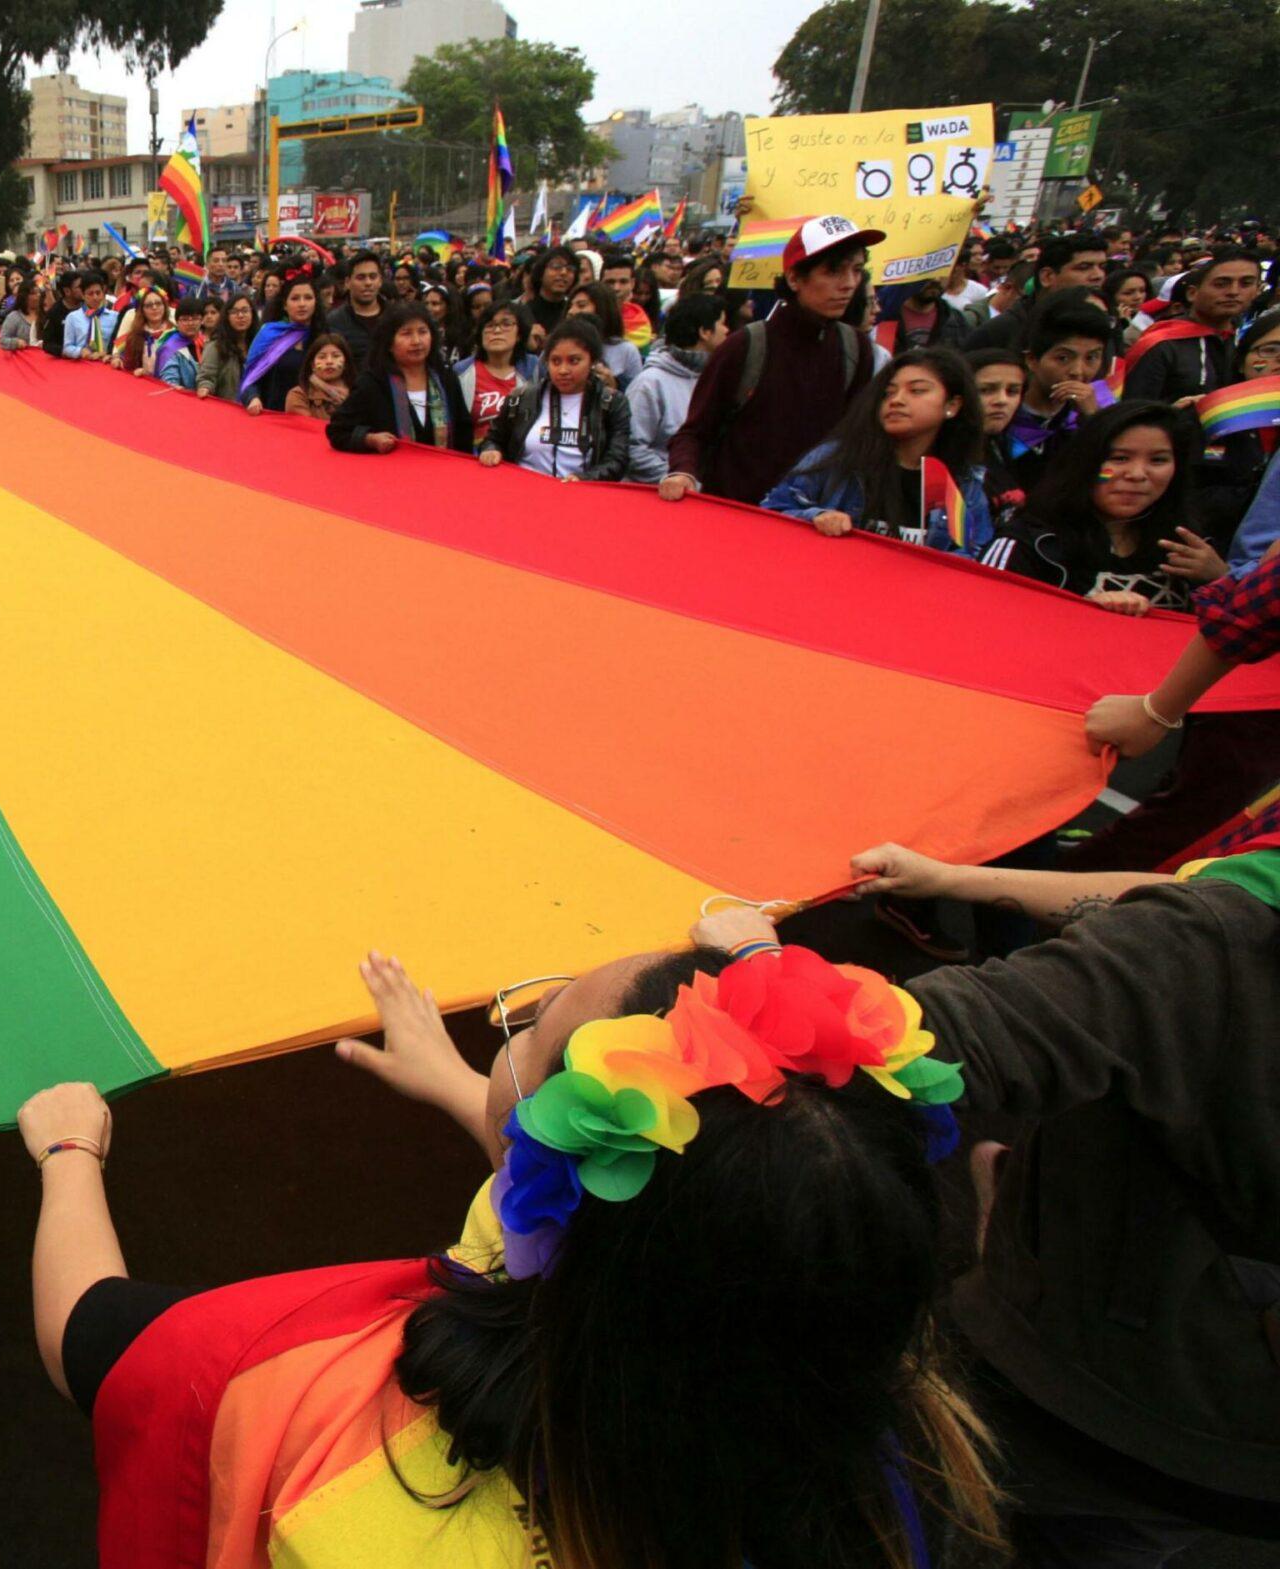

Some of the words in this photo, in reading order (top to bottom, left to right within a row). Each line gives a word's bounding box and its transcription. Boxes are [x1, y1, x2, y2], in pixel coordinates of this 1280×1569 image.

[748, 127, 775, 151] Te
[926, 120, 969, 137] WADA
[884, 248, 956, 277] GUERRERO
